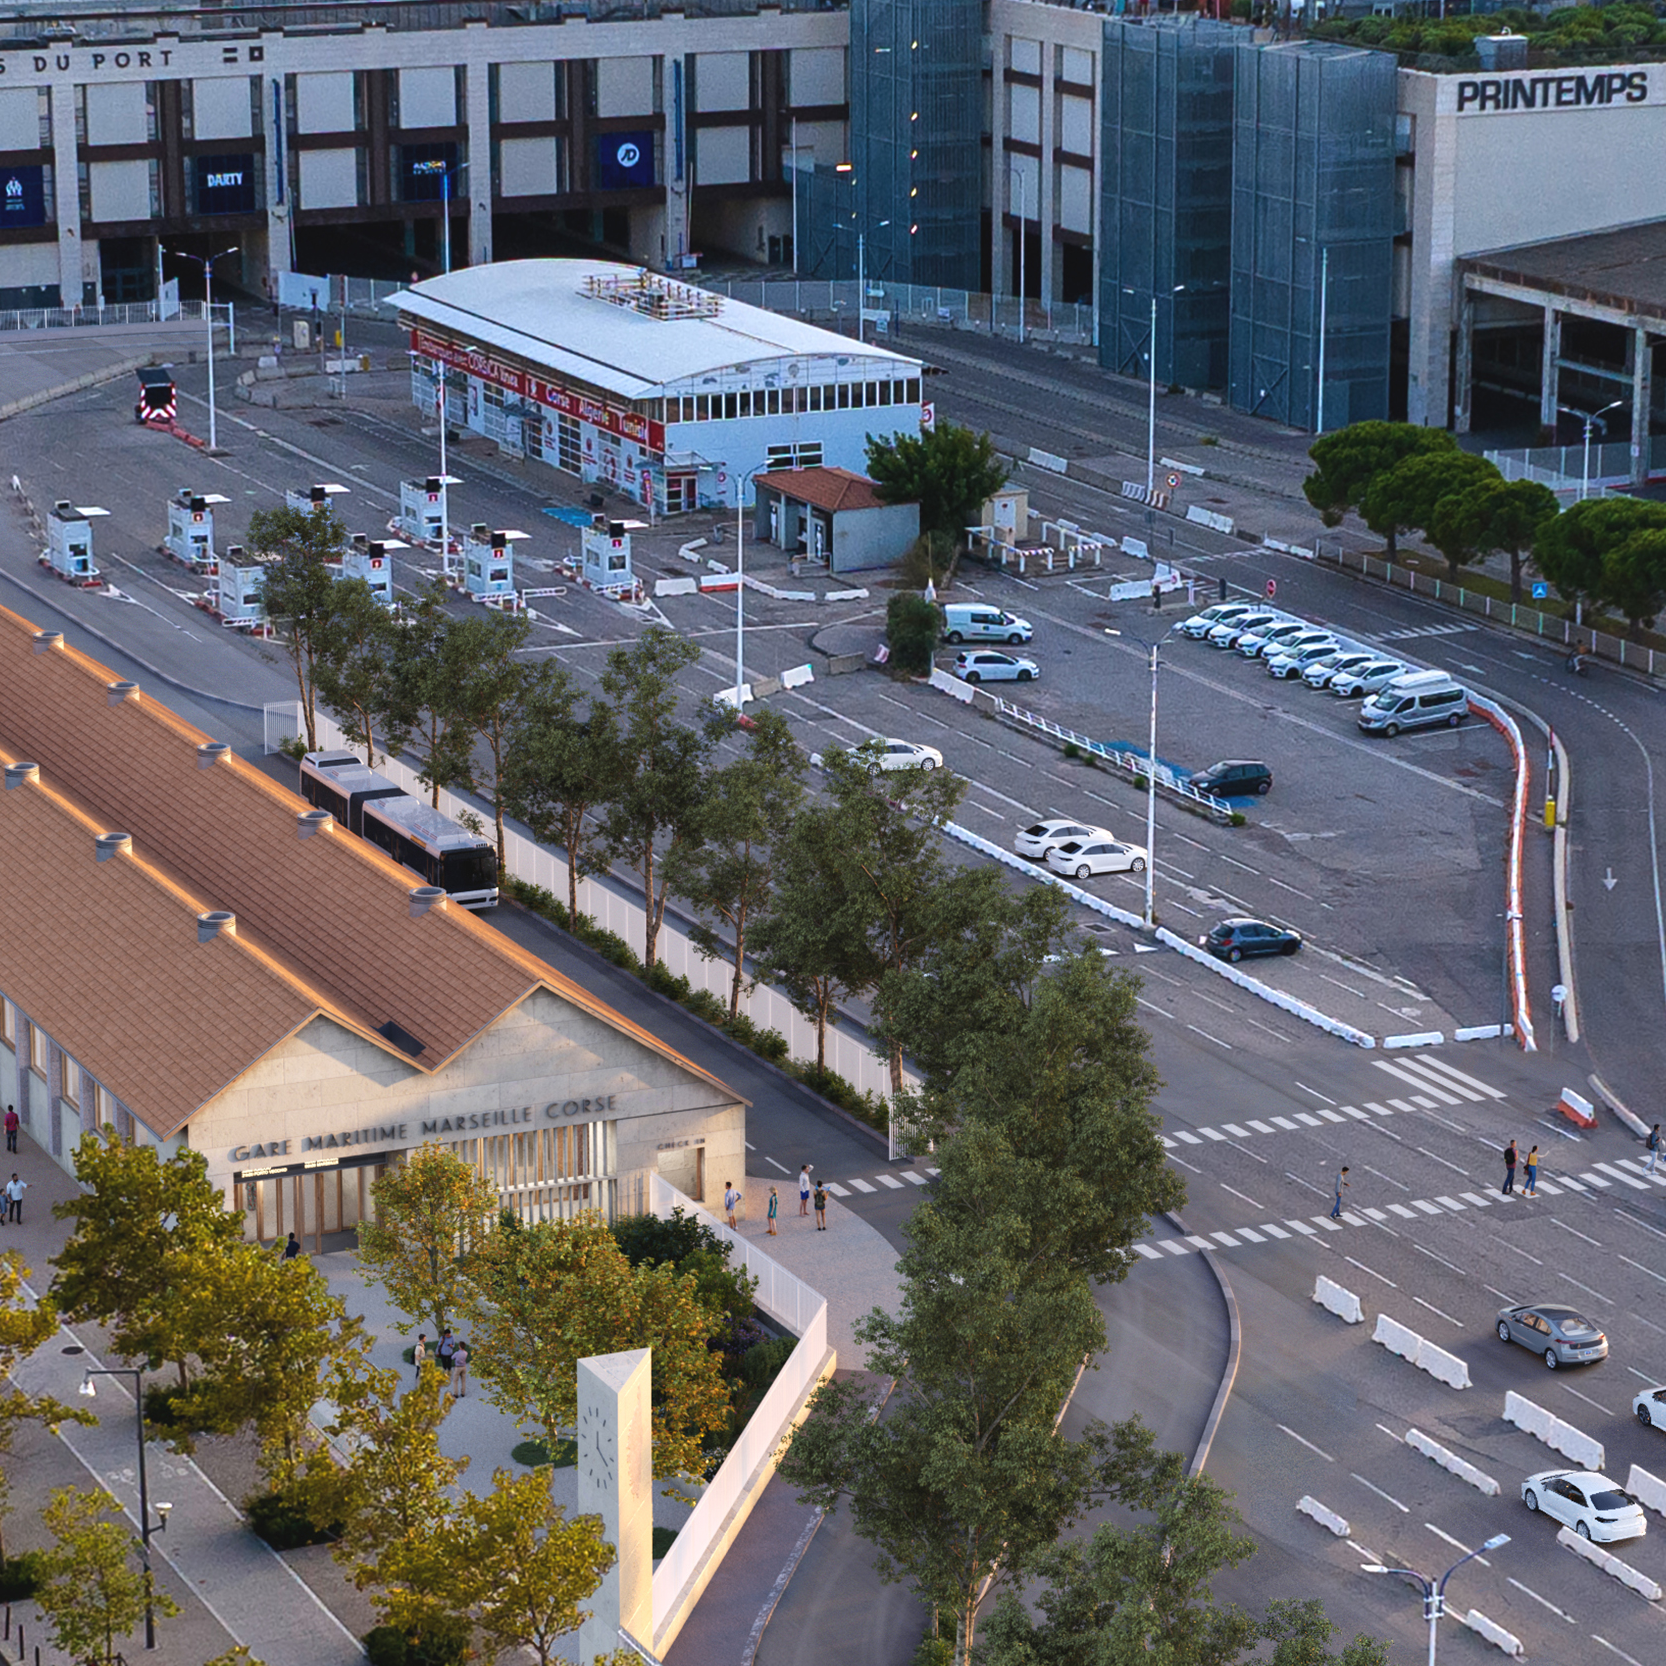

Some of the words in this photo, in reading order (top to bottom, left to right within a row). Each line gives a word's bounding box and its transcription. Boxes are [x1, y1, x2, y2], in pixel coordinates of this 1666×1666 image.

[33, 54, 70, 72] DU
[92, 50, 173, 70] PORT
[1457, 72, 1647, 112] PRINTEMPS
[207, 172, 243, 188] DARTY
[546, 385, 570, 410] Corse
[230, 1140, 292, 1163] GARE
[306, 1123, 408, 1151] MARITIME
[422, 1106, 533, 1136] MARSEILLE
[546, 1095, 617, 1120] CORSE
[657, 1140, 689, 1151] CHECK
